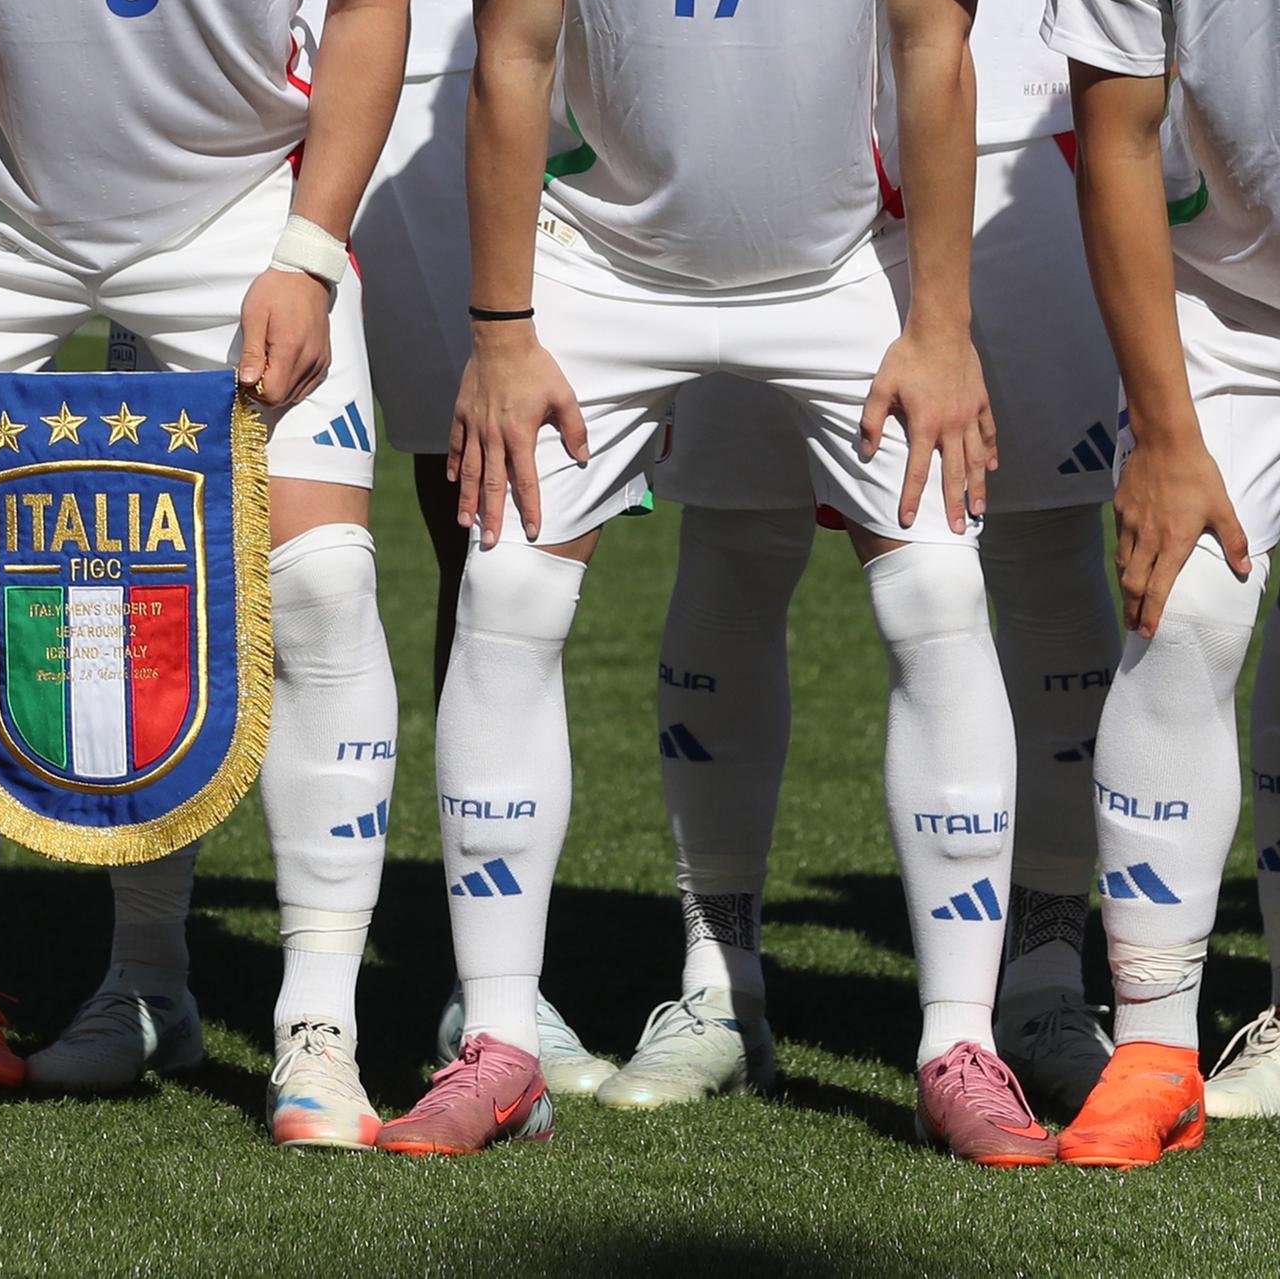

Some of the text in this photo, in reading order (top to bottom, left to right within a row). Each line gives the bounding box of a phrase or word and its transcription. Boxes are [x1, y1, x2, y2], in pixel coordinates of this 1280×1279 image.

[4, 492, 187, 552] ITALIA
[70, 557, 122, 581] FIGC
[29, 602, 63, 617] ITALY
[105, 602, 147, 616] UNDER
[151, 601, 163, 616] 17
[55, 624, 137, 638] UEFA ROUND 2
[45, 646, 99, 660] ICELAND
[113, 645, 148, 659] ITALY
[133, 667, 159, 680] 2026
[441, 793, 537, 819] ITALIA
[1093, 780, 1189, 821] TALIA
[914, 810, 1009, 835] ITALIA
